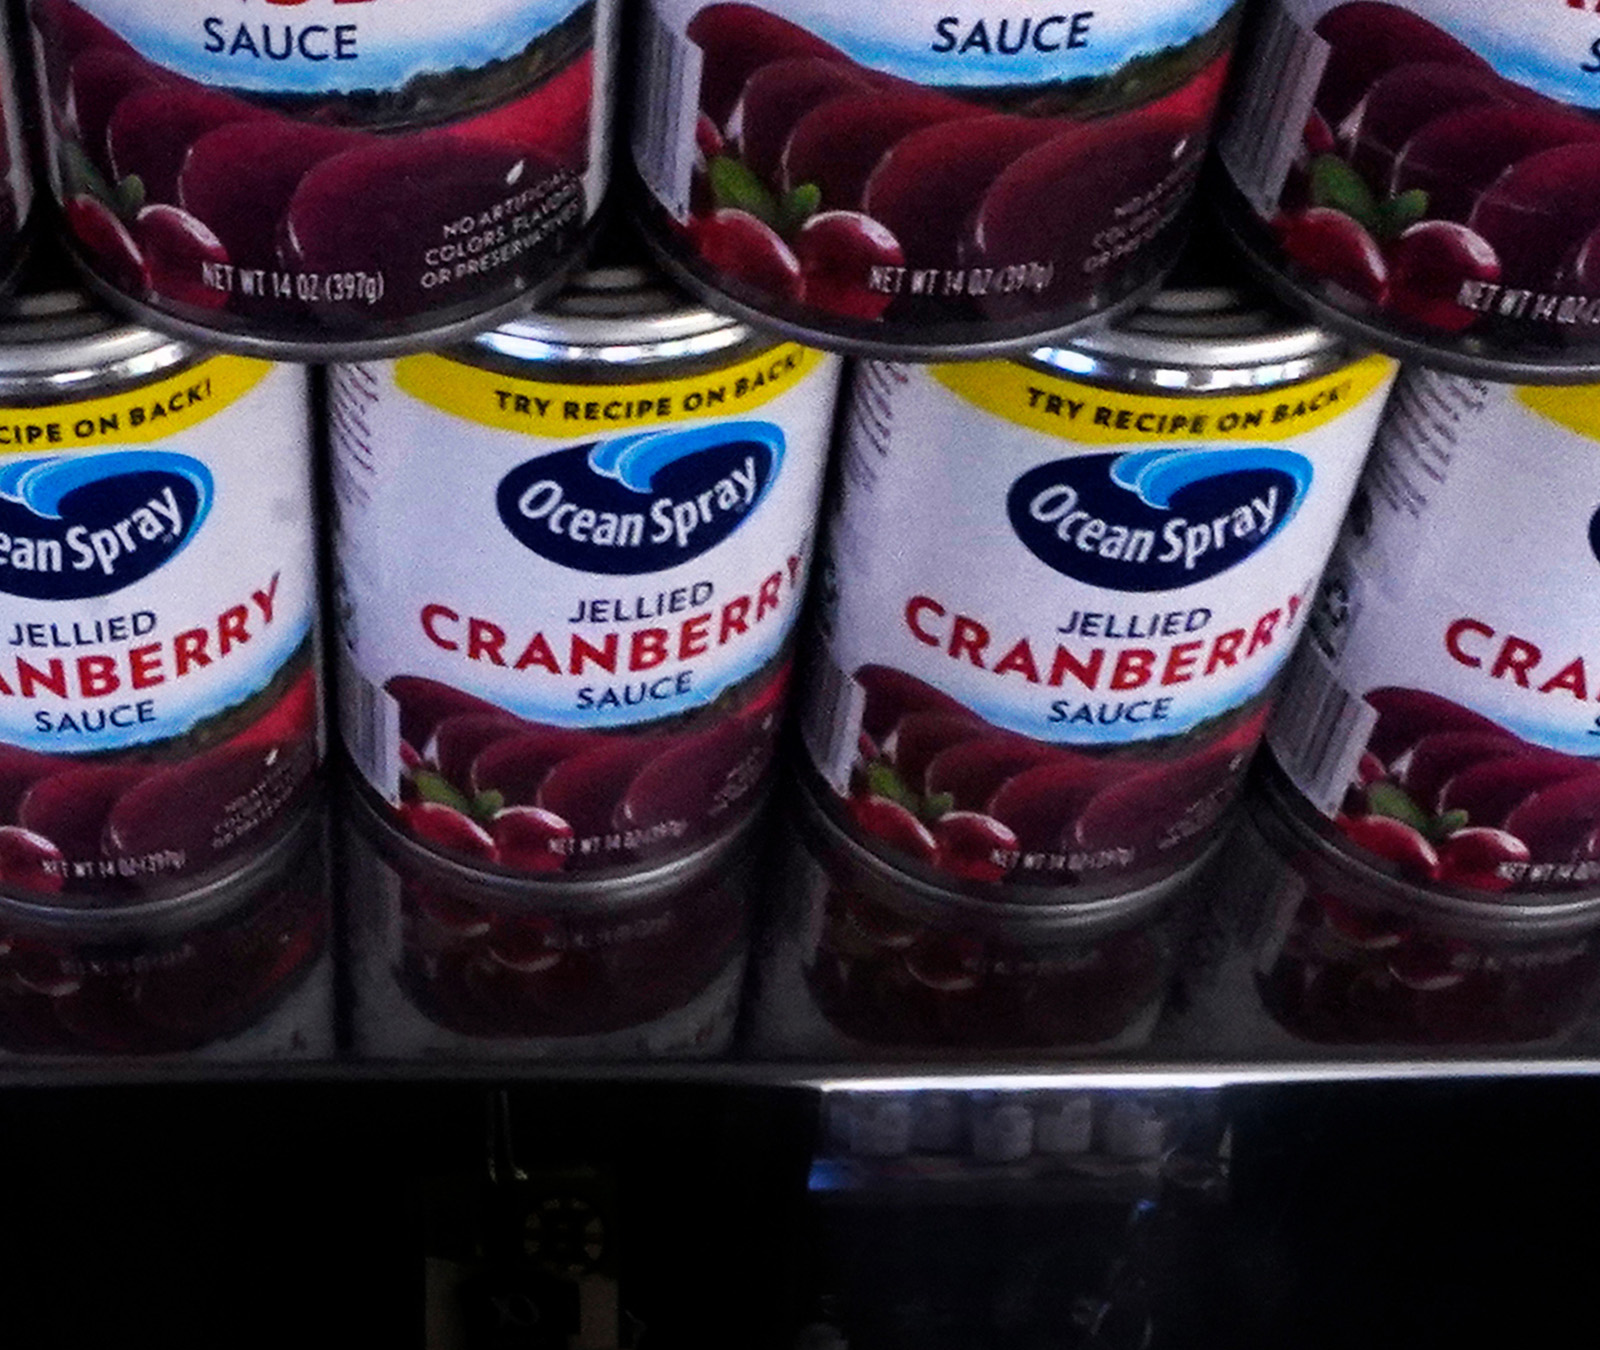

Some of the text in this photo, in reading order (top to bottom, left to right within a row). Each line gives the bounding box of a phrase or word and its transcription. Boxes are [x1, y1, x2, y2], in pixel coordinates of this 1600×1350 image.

[203, 17, 359, 61] SAUCE
[931, 11, 1095, 56] SAUCE
[202, 261, 385, 305] NET WT 14 OZ (397g)
[74, 414, 119, 440] ON
[129, 379, 213, 429] BACK!
[493, 389, 550, 418] TRY
[562, 397, 673, 422] RECIPE
[682, 384, 728, 414] ON
[1026, 386, 1084, 421] TRY
[1093, 408, 1206, 435] RECIPE
[1216, 408, 1263, 433] ON
[568, 580, 715, 626] JELLIED
[1058, 607, 1213, 641] JELLIED
[7, 609, 158, 650] JELLIED
[576, 670, 693, 711] SAUCE
[35, 701, 156, 734] SAUCE
[1046, 697, 1174, 728] SAUCE
